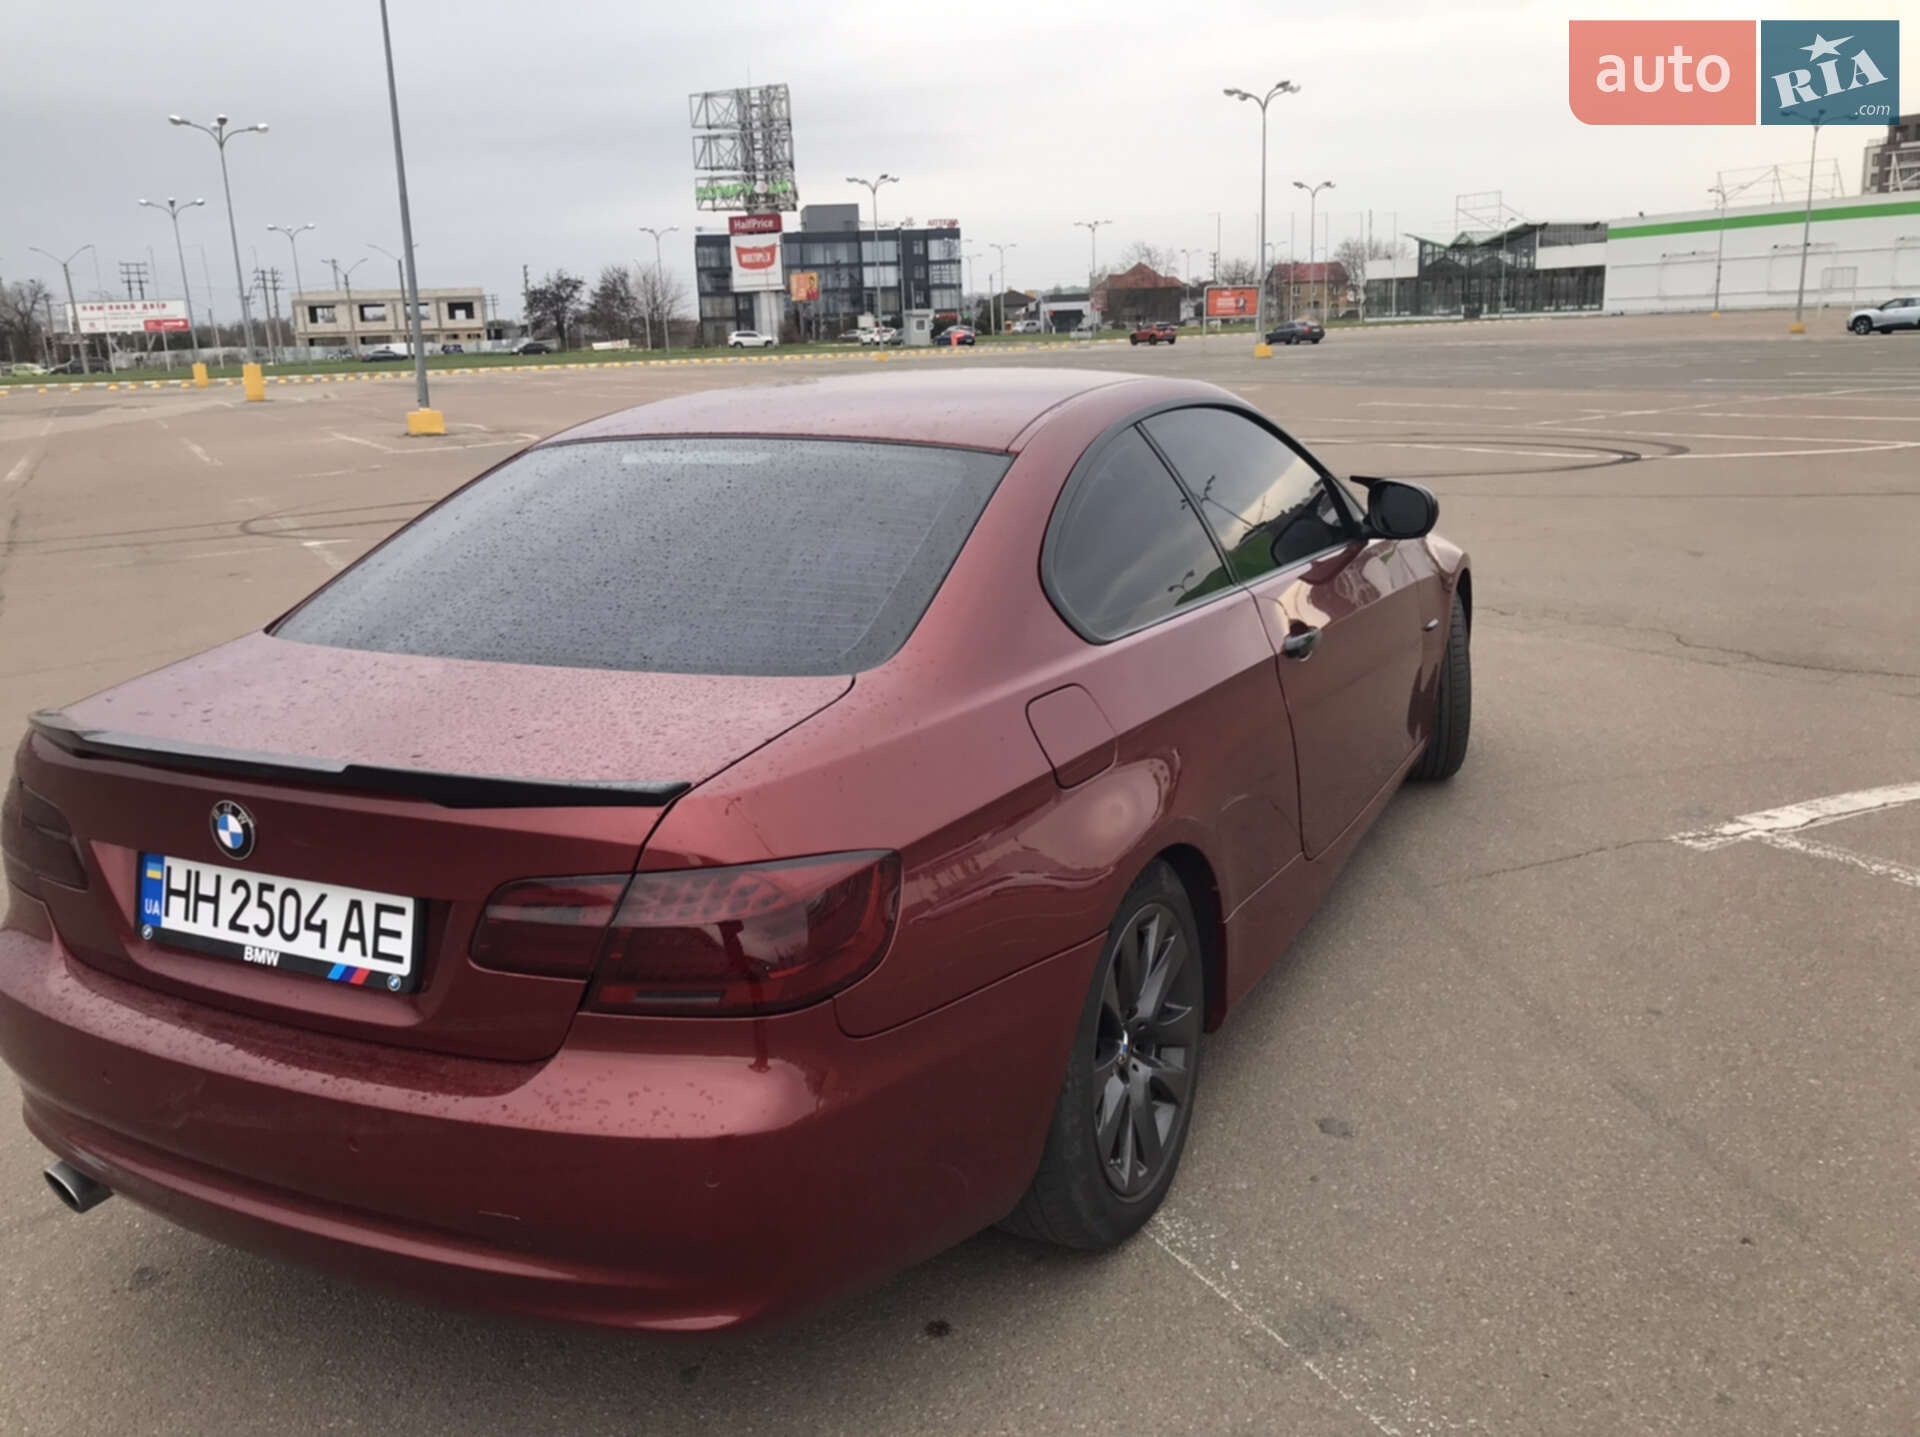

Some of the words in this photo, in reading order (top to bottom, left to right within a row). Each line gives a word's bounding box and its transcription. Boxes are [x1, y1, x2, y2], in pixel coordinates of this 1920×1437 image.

[734, 218, 773, 230] HalfPrice
[144, 898, 160, 916] UA
[164, 865, 221, 928] HH
[228, 879, 328, 949] 2504
[338, 899, 406, 965] AE
[243, 945, 280, 967] BMW
